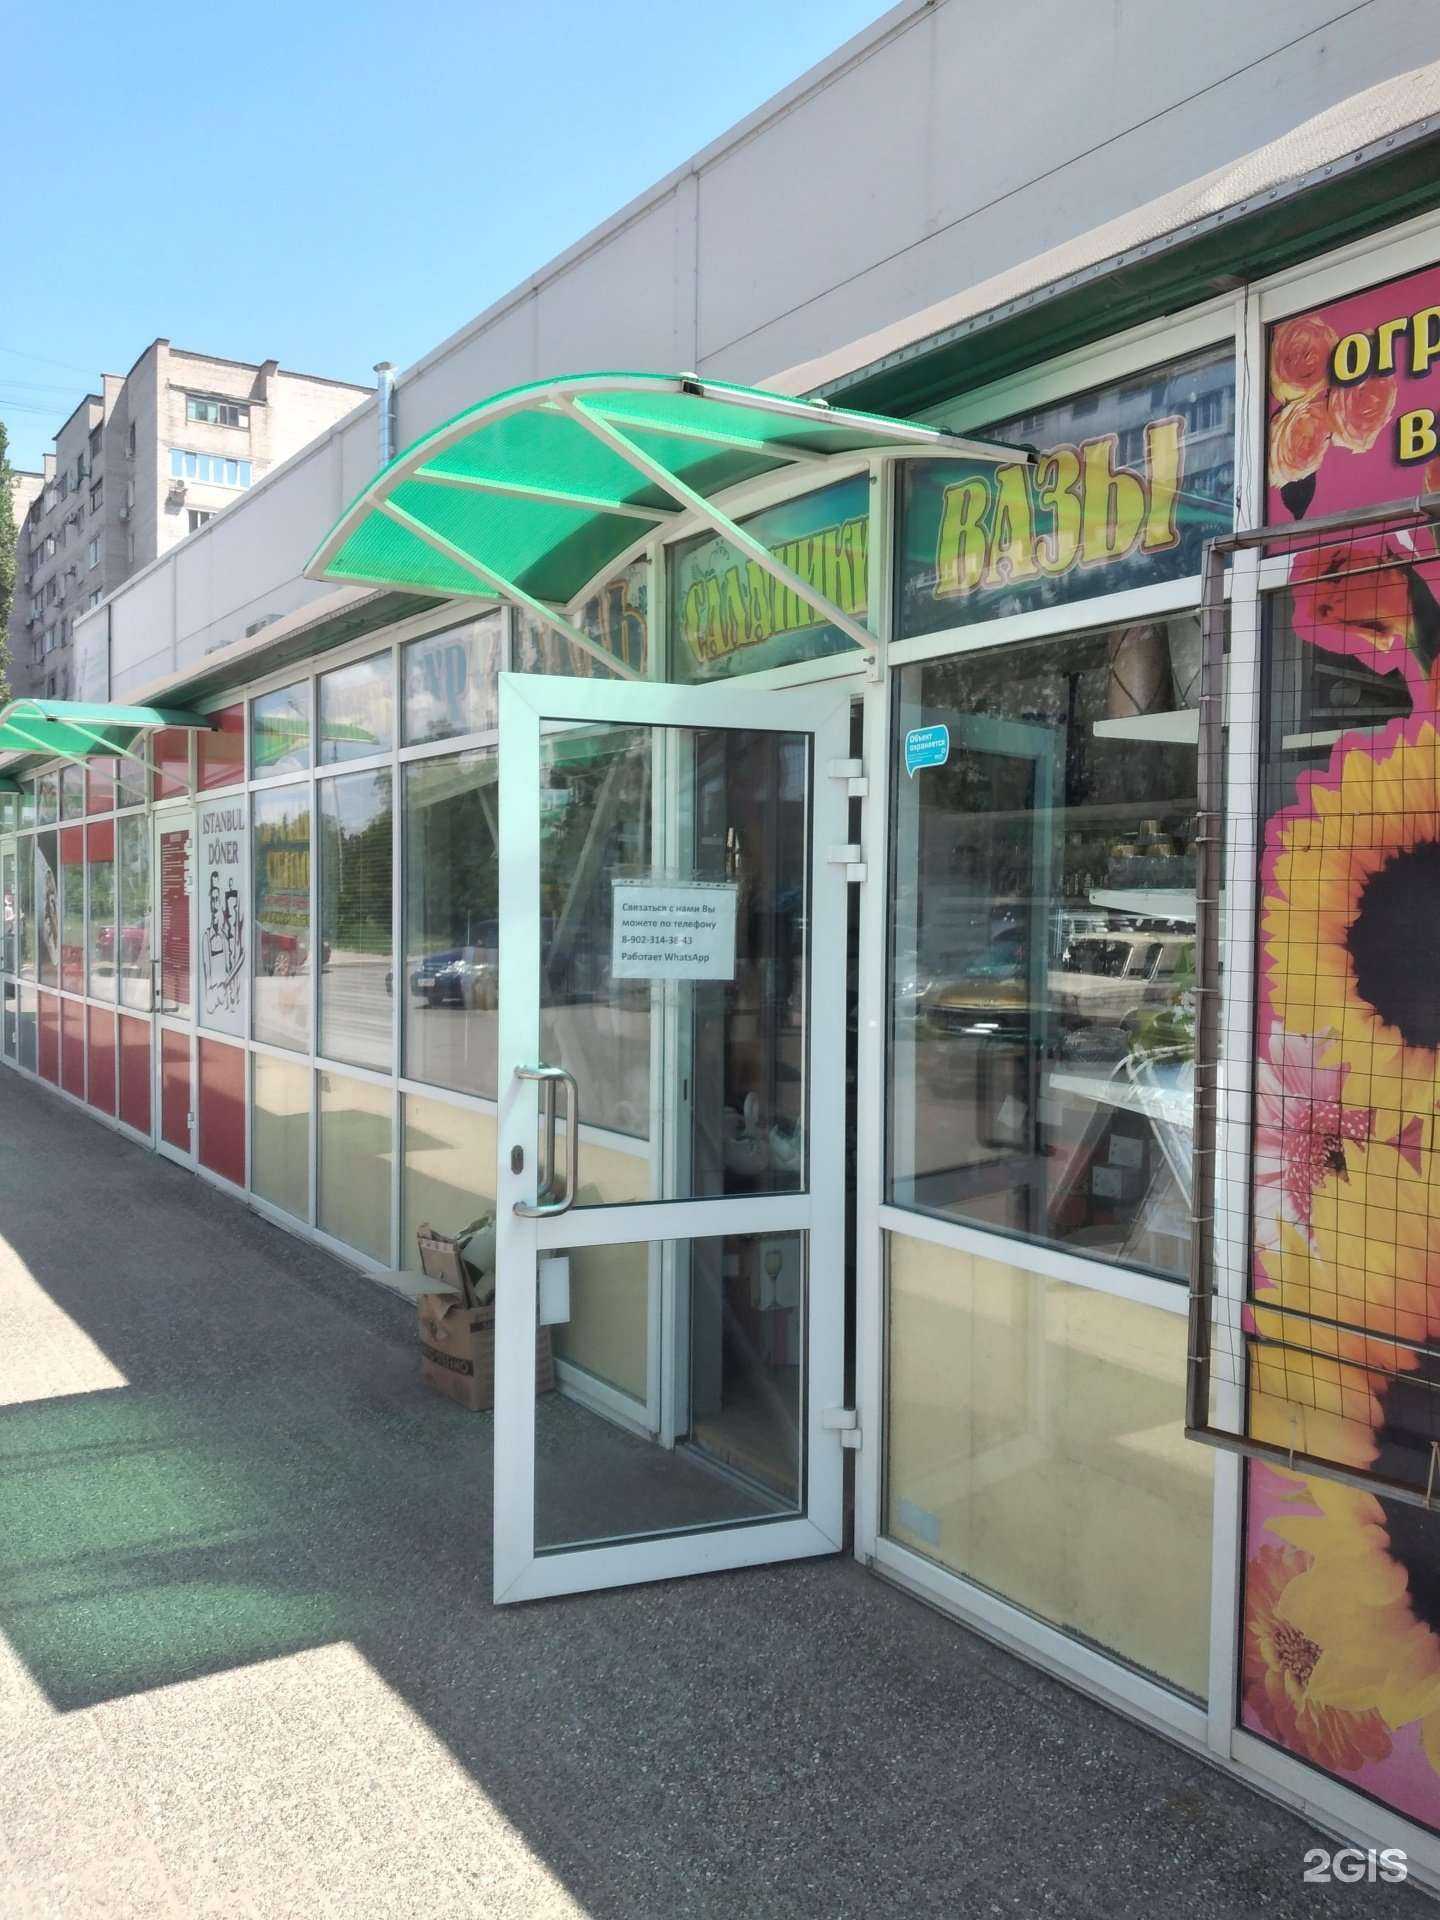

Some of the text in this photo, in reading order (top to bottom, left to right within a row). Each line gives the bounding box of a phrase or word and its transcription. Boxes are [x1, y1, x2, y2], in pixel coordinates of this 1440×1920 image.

[933, 415, 1186, 600] ВАЗЫ
[202, 807, 246, 835] ISTANBUL
[622, 902, 667, 912] Связаться
[676, 905, 700, 913] нами
[702, 903, 716, 913] Вы
[622, 920, 717, 930] можете по телефону
[621, 952, 710, 963] Работает WhatsApp
